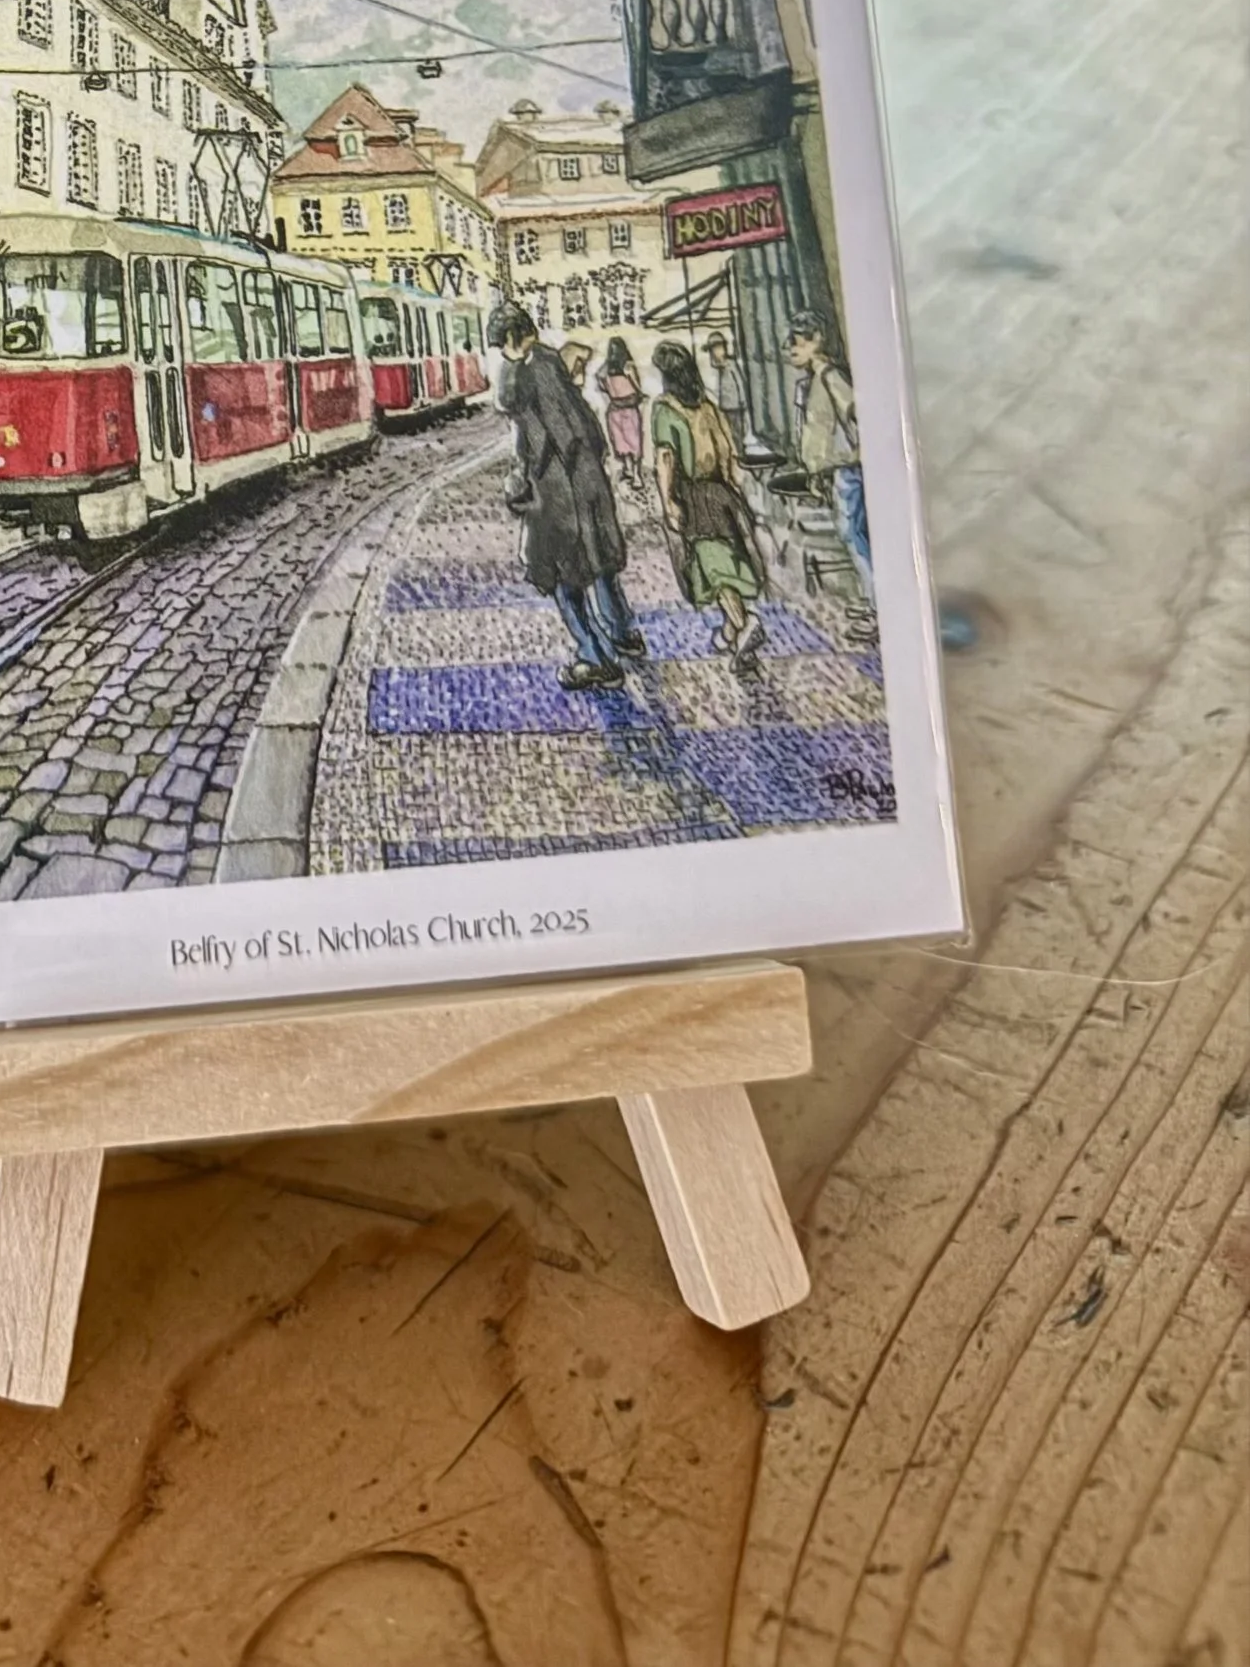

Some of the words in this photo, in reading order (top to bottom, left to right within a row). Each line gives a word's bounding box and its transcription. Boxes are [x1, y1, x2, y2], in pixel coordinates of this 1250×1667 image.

[170, 934, 236, 971] Belfry
[244, 928, 273, 960] of
[277, 928, 312, 958] St.
[317, 920, 419, 957] Nicholas
[427, 908, 523, 944] Church,
[529, 907, 590, 935] 2025
